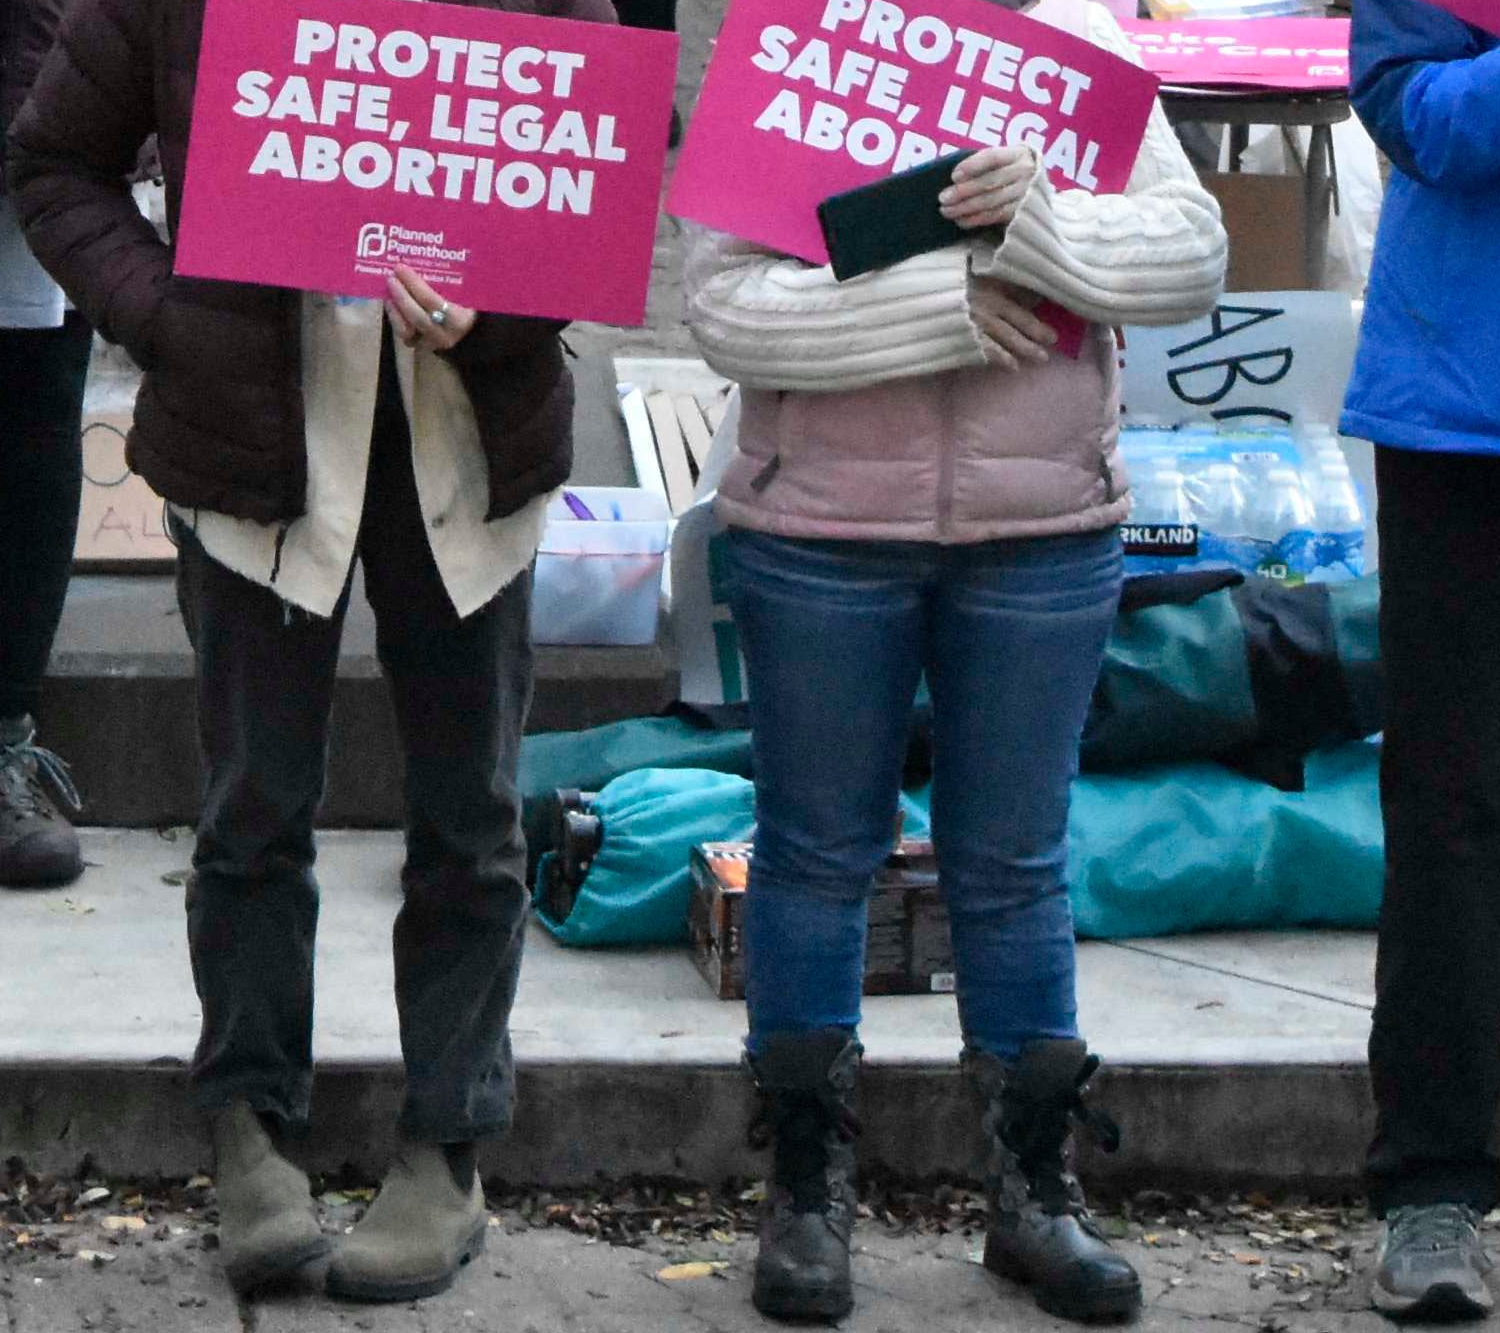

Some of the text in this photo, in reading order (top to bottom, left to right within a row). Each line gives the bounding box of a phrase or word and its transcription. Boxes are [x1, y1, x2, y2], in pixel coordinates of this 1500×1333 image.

[293, 18, 586, 99] PROTECT
[232, 70, 627, 163] SAFE, LEGAL
[750, 24, 1100, 192] SAFE, LEGAL
[248, 130, 596, 216] ABORTION
[387, 239, 467, 262] Parenthood
[388, 224, 444, 245] Planned
[1120, 525, 1195, 544] RKLAND
